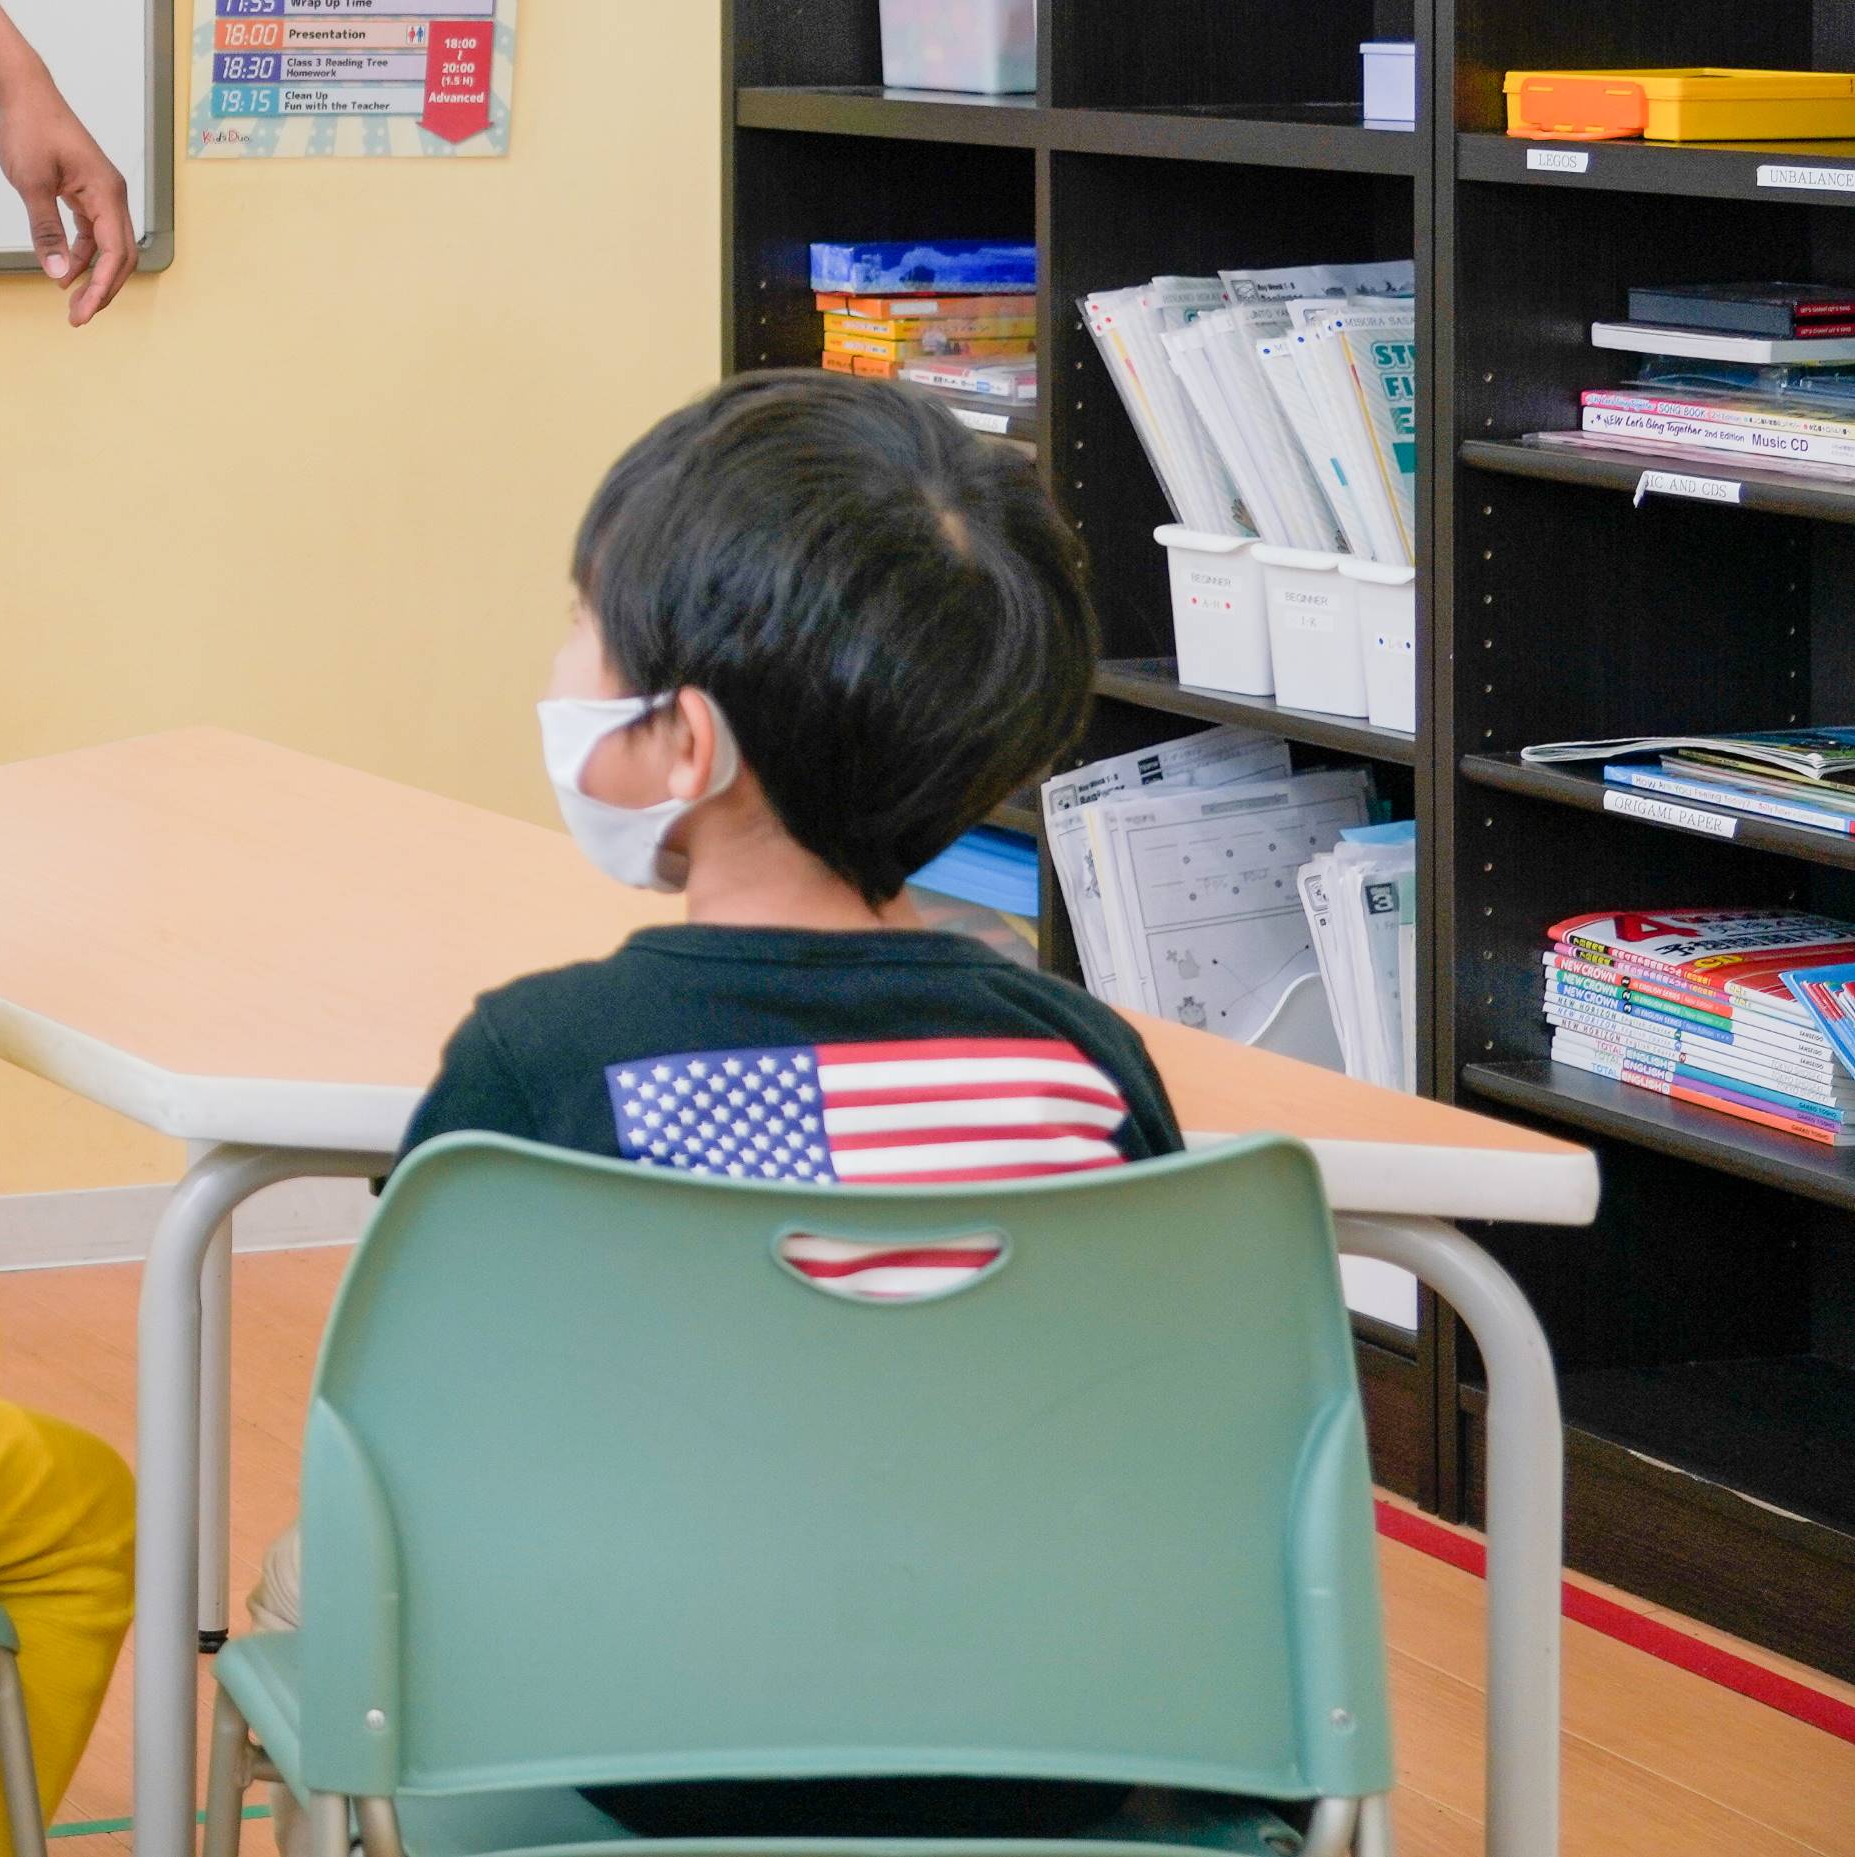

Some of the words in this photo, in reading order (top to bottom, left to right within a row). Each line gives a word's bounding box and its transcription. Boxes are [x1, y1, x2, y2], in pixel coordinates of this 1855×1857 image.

[223, 23, 278, 47] 18:00
[288, 27, 367, 41] Presentation
[428, 91, 485, 105] Advanced
[1538, 152, 1578, 169] LEGOS
[1751, 433, 1787, 450] Music
[1790, 438, 1809, 452] CD
[1613, 797, 1673, 820] ORIGAMI
[1679, 809, 1722, 832] PAPER
[1560, 958, 1586, 976] NEW
[1583, 963, 1617, 984] CROWN
